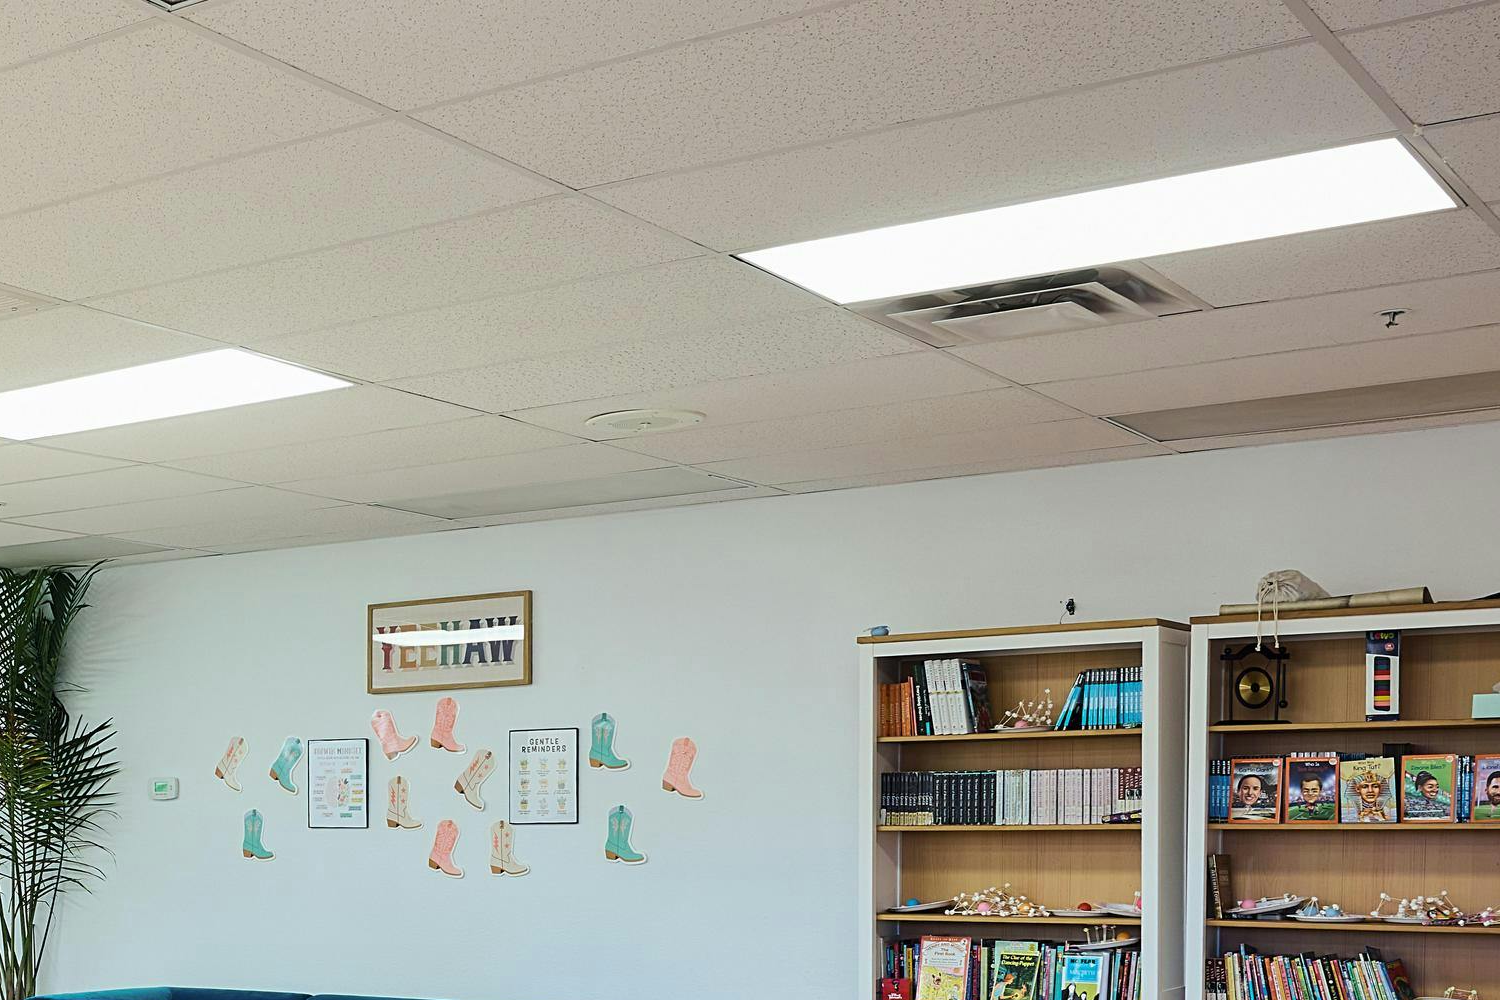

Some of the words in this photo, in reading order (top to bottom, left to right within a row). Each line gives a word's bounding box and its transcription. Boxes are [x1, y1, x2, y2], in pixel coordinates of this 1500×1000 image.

[376, 615, 520, 671] YEEHAW
[529, 737, 559, 746] GENTLE
[521, 745, 567, 753] REMINDERS
